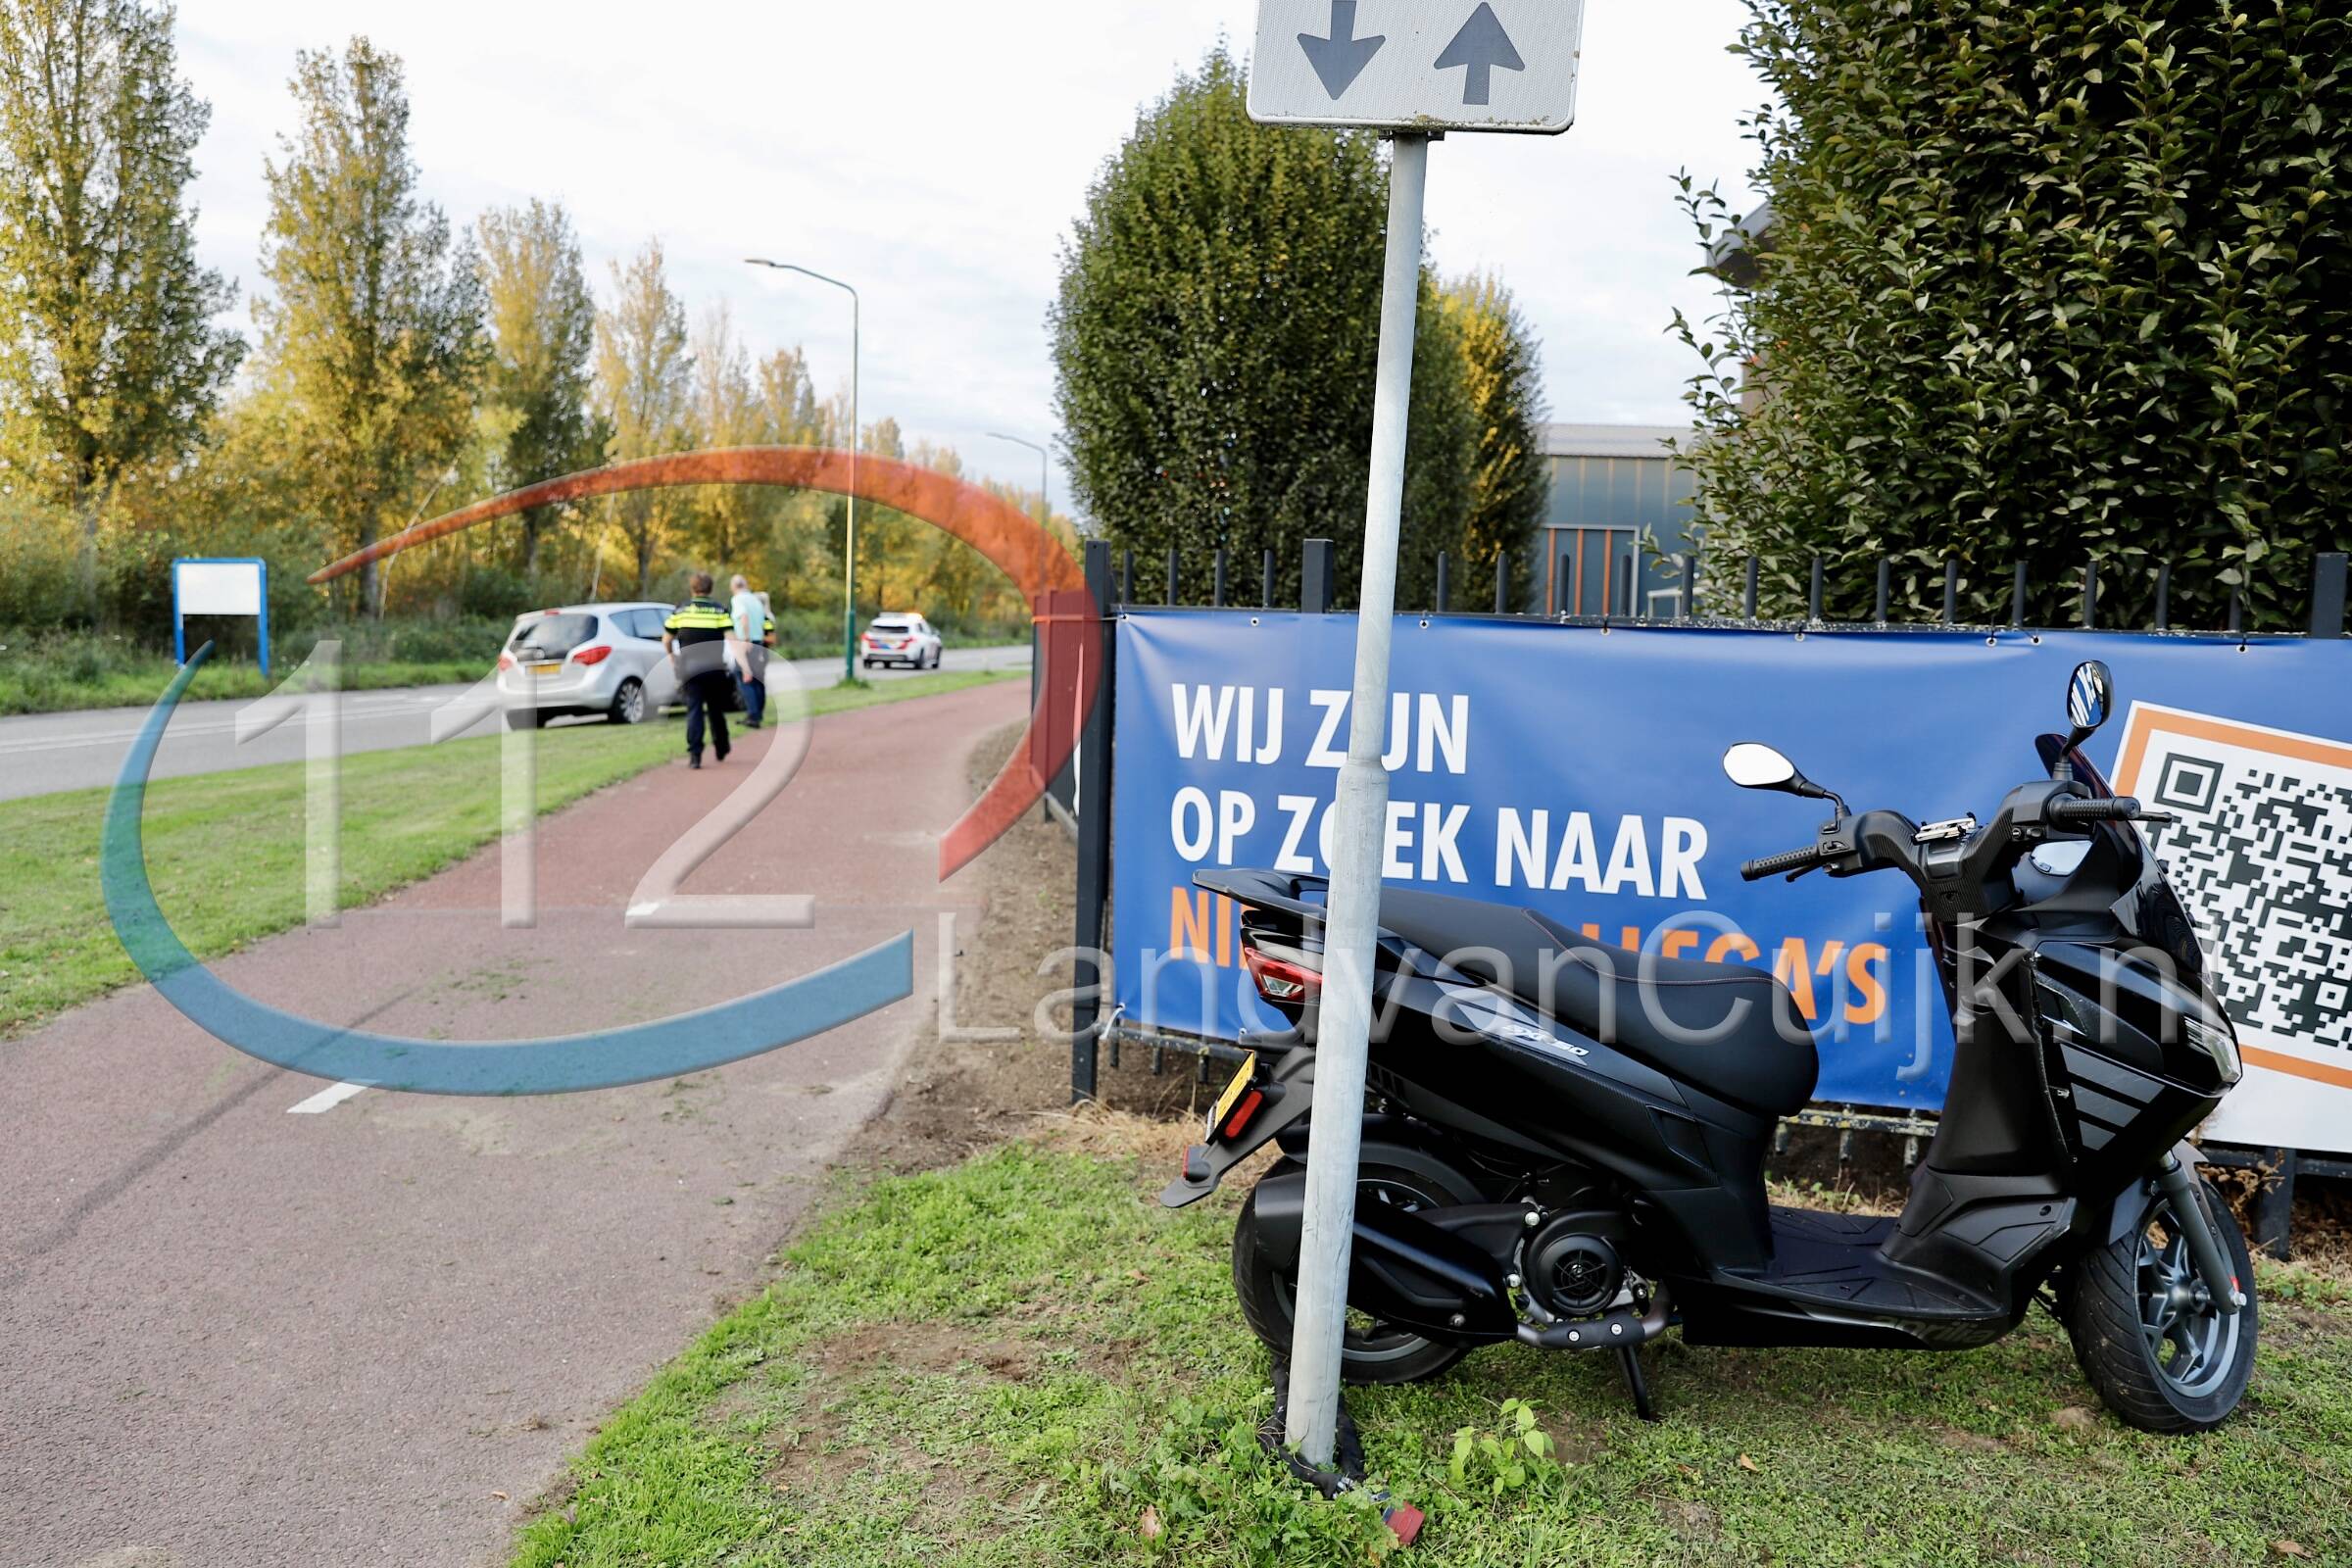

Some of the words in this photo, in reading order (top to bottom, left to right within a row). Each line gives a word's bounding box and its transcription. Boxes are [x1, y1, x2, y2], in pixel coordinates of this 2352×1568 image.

[1171, 683, 1284, 764] WIJ
[1304, 689, 1469, 774] ZJN
[1170, 786, 1255, 865] OP
[1494, 807, 1708, 900] NAAR
